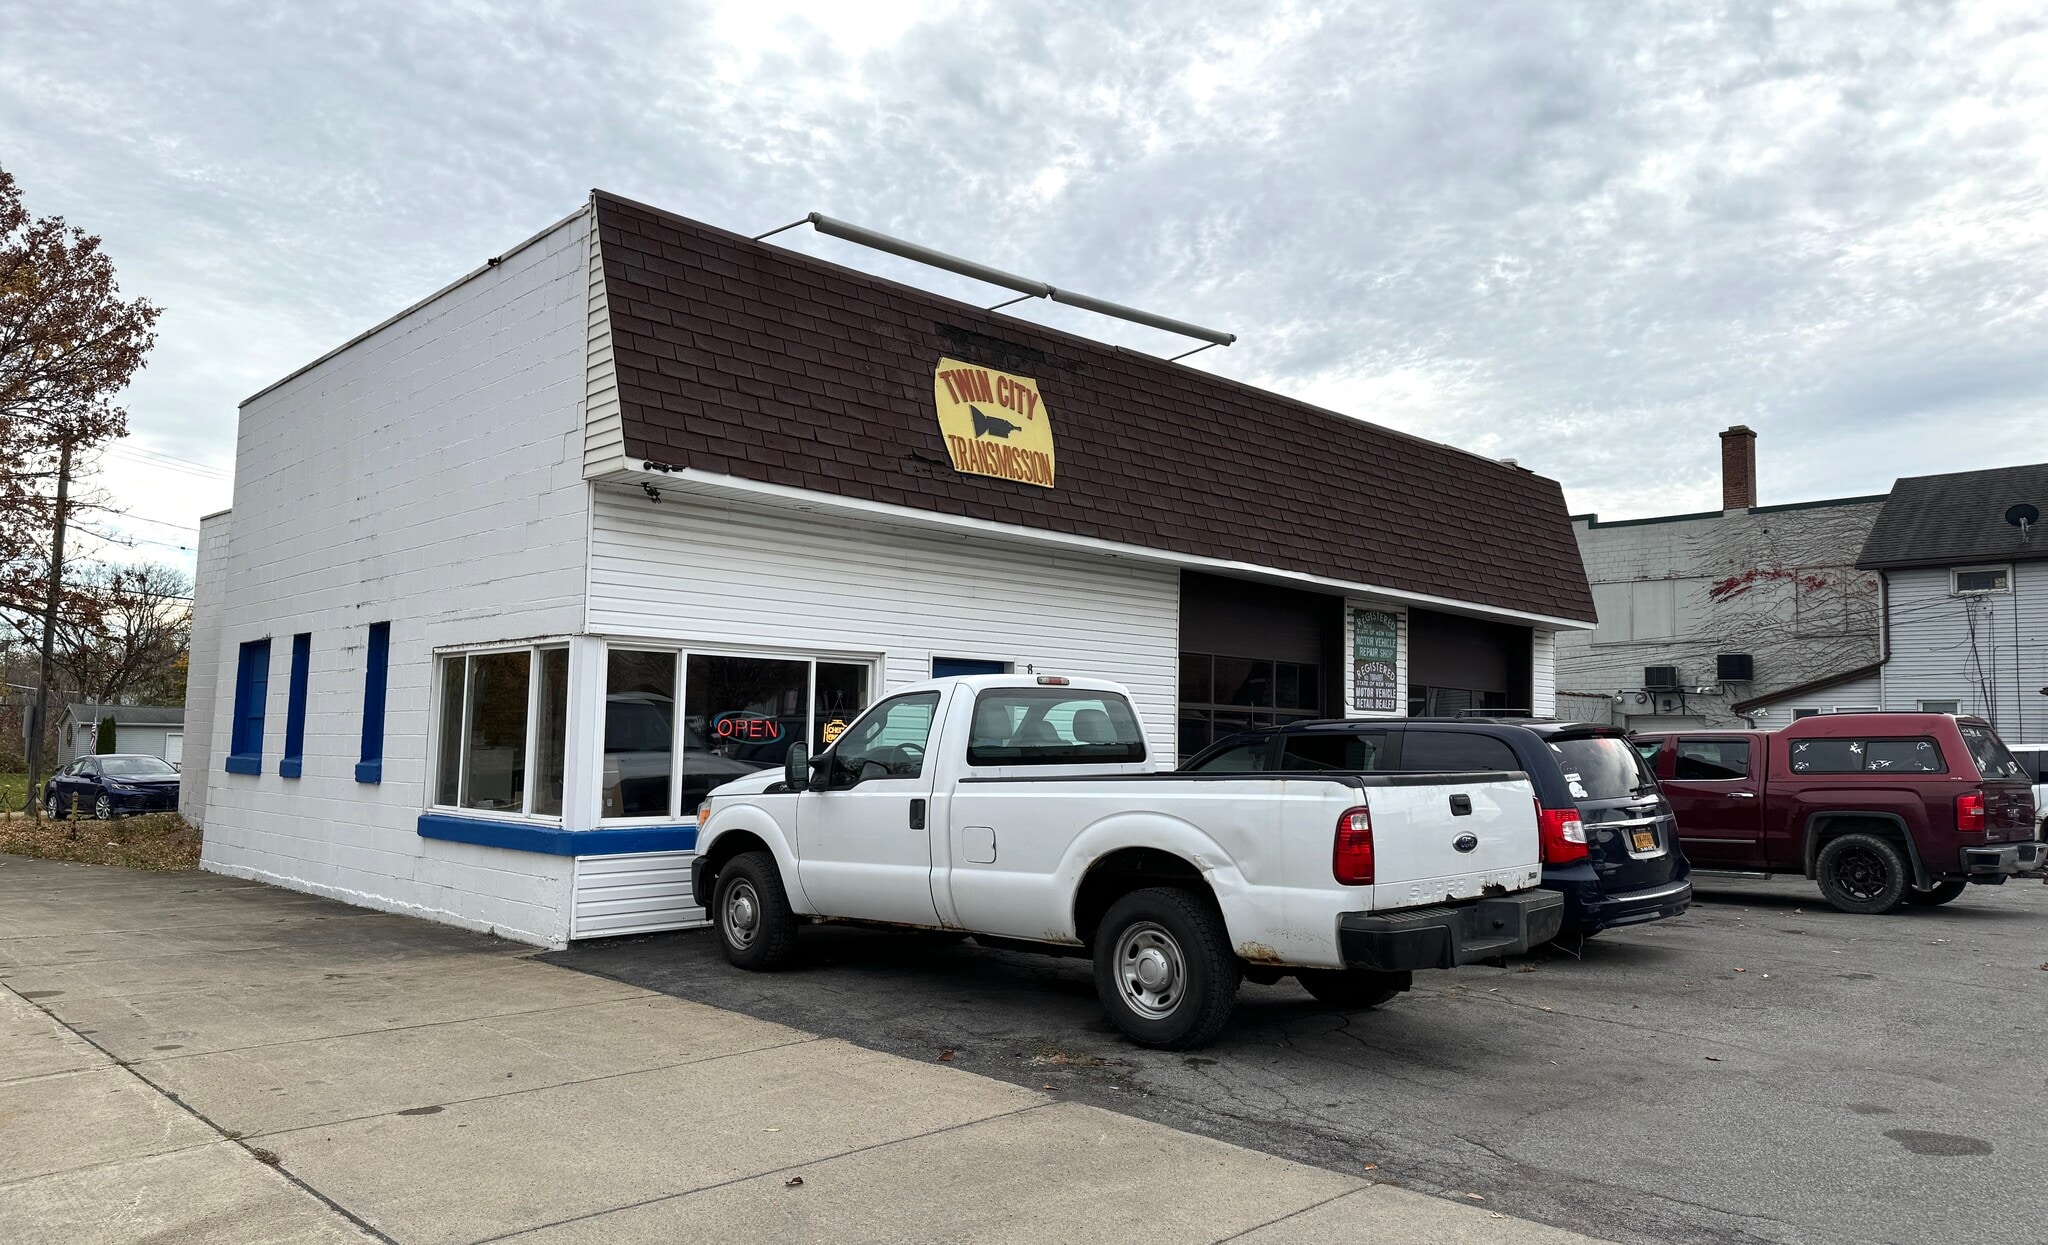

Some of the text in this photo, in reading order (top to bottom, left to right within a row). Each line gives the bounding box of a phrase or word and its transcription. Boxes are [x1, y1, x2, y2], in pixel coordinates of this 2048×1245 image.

[938, 368, 1039, 421] TWIN CITY
[948, 434, 1053, 487] TRANSMISSION
[1356, 611, 1396, 630] REGISTERED
[1356, 635, 1396, 648] MOTOR VEHICLE
[1360, 646, 1394, 659] REPAIR SHOP
[1356, 661, 1396, 681] REGISTERED
[1355, 687, 1396, 699] MOTOR VEHICLE
[1356, 698, 1395, 709] RETAIL DEALER
[717, 719, 779, 738] OPEN
[1409, 878, 1466, 900] SUPER
